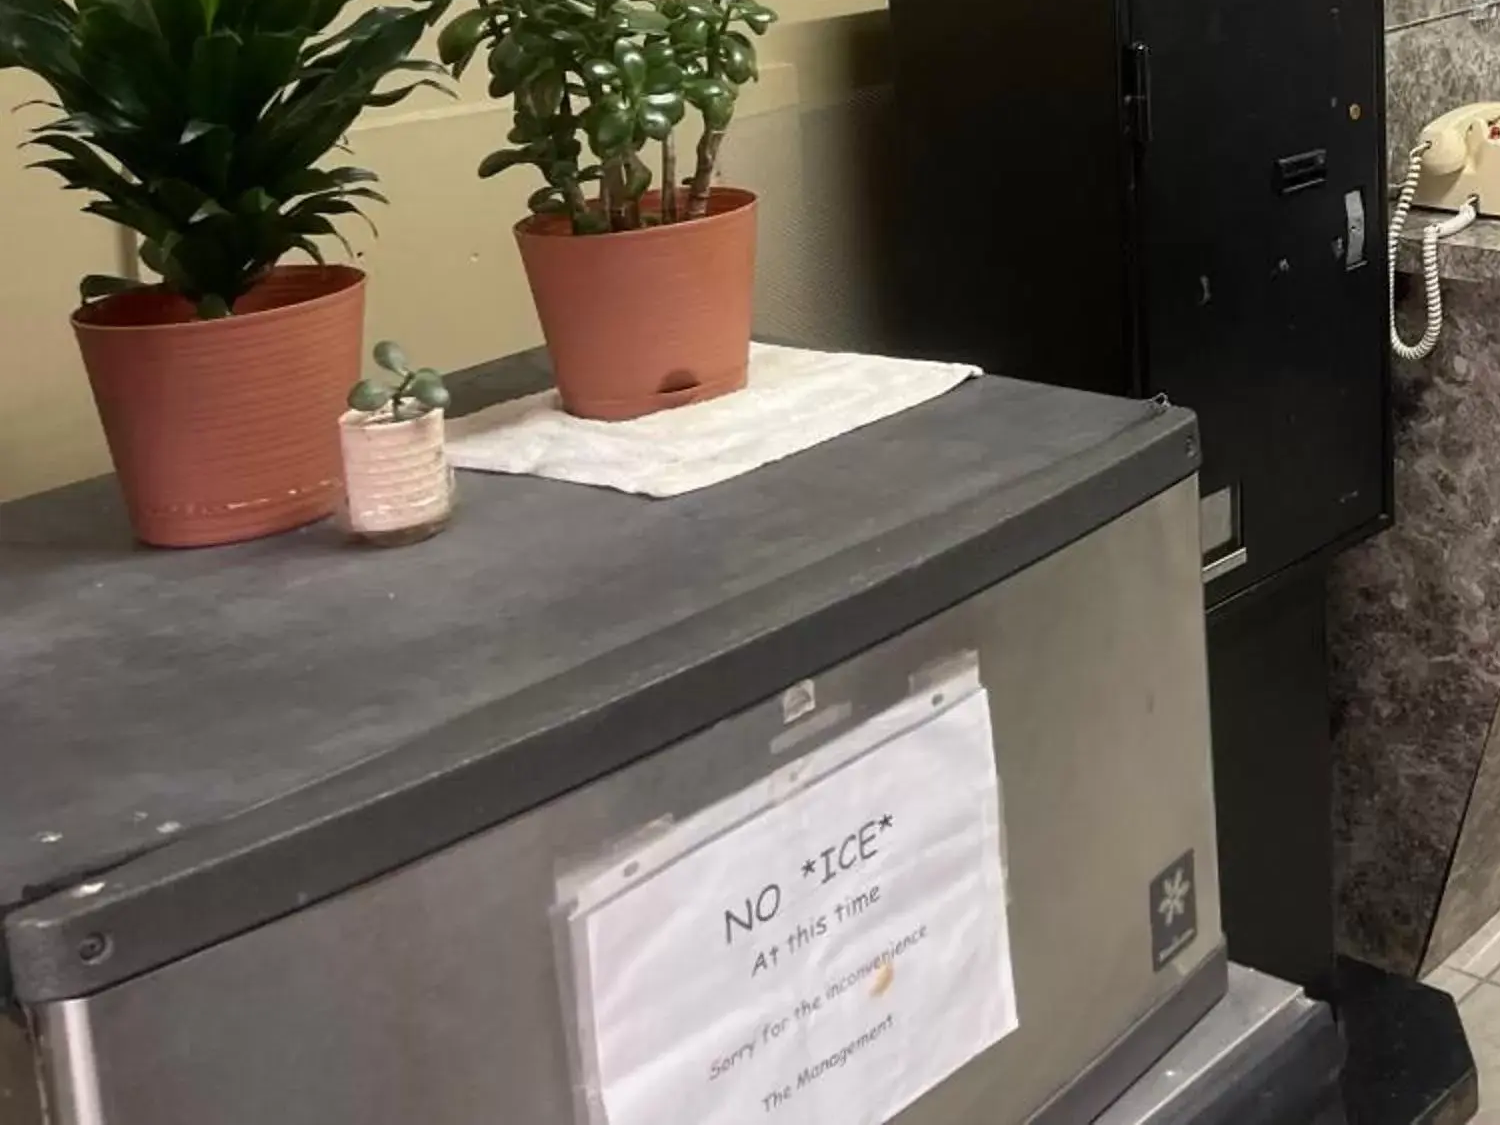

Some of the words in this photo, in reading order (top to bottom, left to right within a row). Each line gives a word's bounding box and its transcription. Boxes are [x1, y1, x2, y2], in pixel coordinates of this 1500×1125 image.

[724, 883, 781, 944] NO
[752, 946, 778, 978] At
[787, 915, 827, 954] this
[835, 883, 880, 923] time
[709, 1041, 757, 1081] Sorry
[762, 1016, 788, 1045] for
[793, 993, 822, 1020] the
[826, 925, 928, 1001] inconvenience
[761, 1083, 792, 1114] The
[796, 1013, 893, 1089] Management
